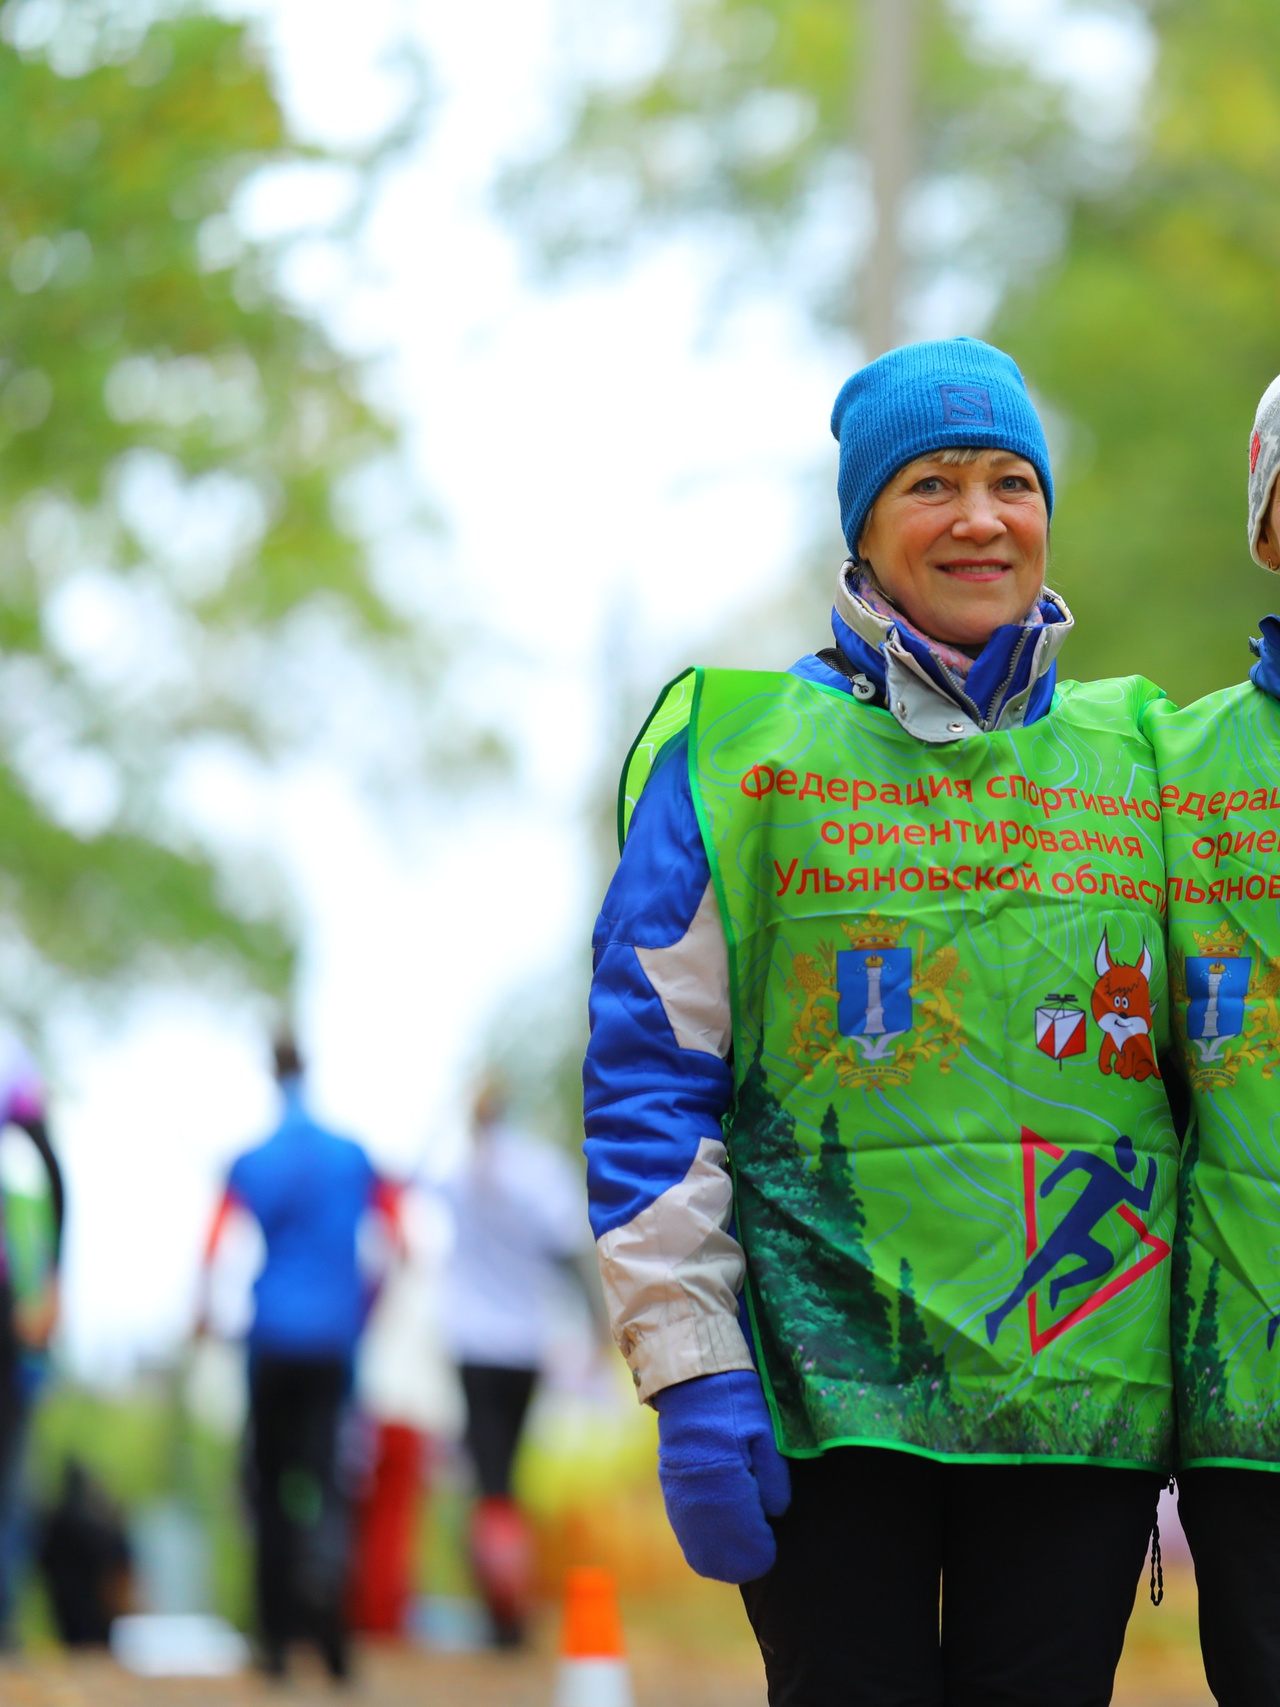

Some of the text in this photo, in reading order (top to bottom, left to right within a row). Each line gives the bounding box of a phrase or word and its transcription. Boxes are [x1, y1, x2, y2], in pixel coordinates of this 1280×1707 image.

[740, 763, 1161, 822] Федерация спортивно
[820, 819, 1144, 860] ориентирования
[773, 858, 1043, 897] Ульяновской
